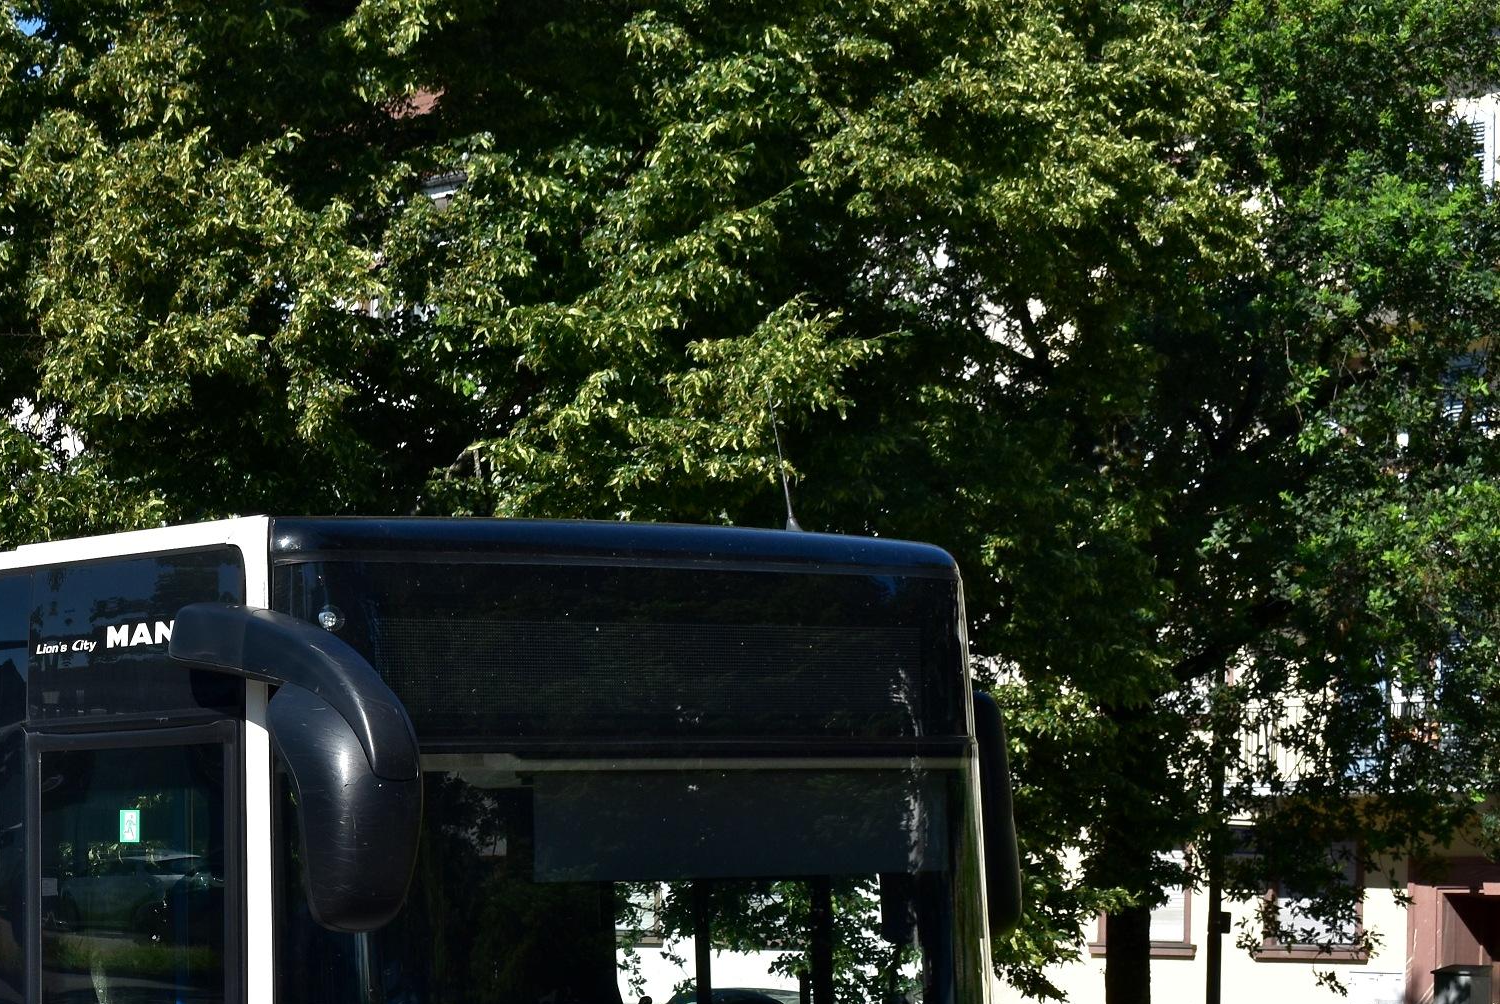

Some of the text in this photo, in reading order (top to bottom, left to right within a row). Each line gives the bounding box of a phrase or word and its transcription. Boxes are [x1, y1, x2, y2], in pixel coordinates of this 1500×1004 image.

[106, 619, 176, 649] MAN
[35, 639, 97, 655] Lion's City
